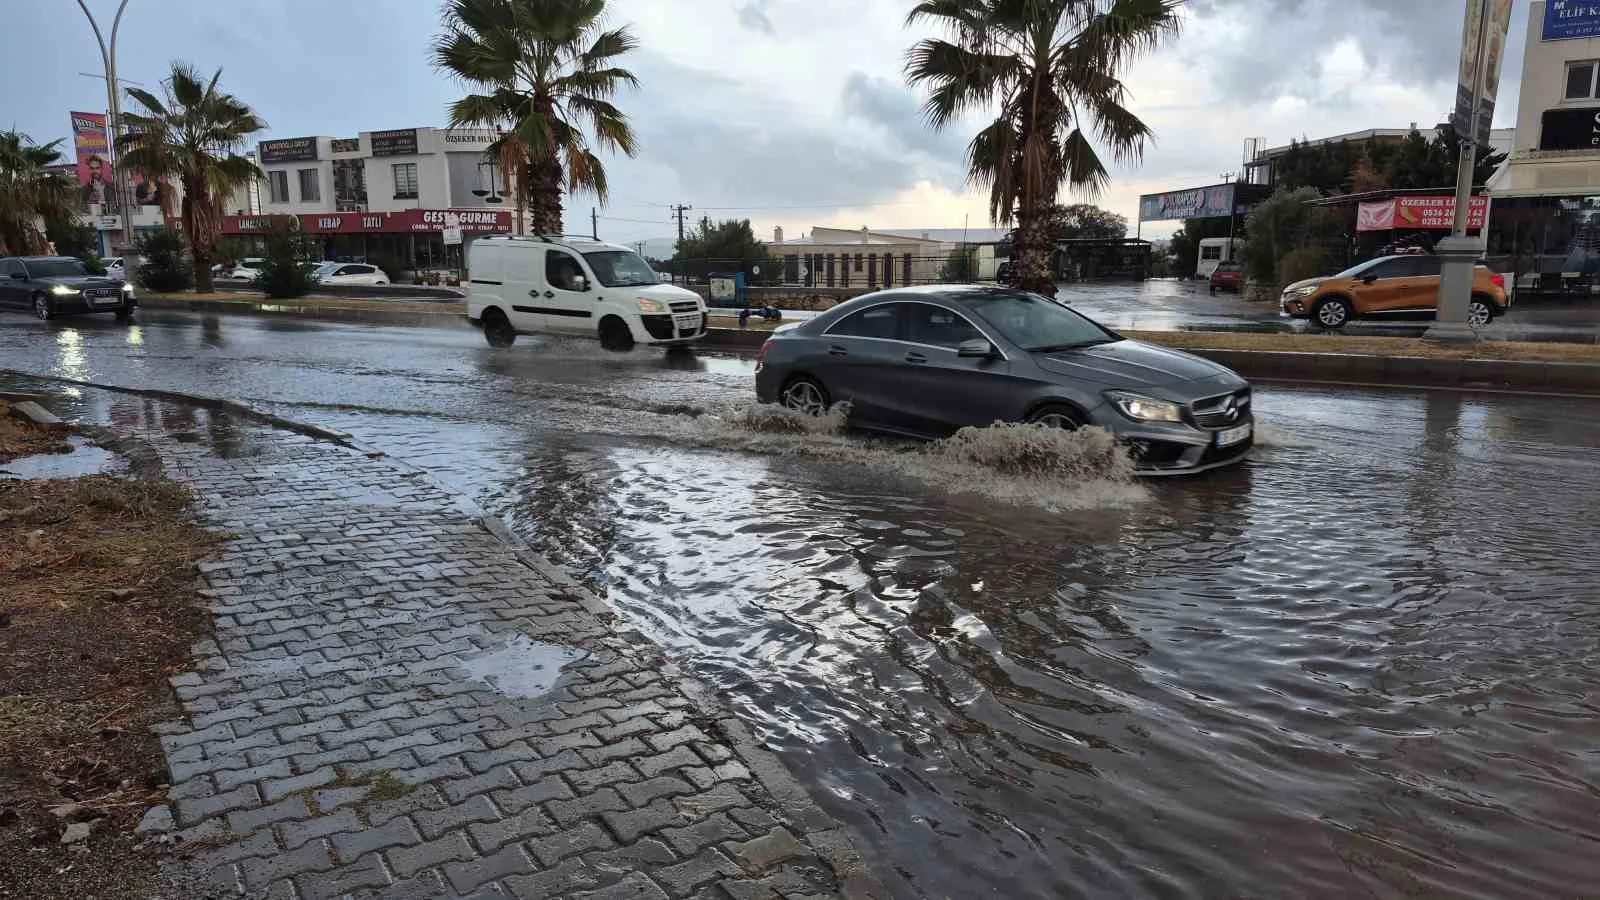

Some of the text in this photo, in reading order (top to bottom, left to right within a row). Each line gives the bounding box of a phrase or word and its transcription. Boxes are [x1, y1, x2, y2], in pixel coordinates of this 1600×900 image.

[1589, 7, 1600, 16] K
[364, 217, 382, 228] TATLI
[424, 211, 497, 224] GEST GURME
[319, 218, 341, 228] KEBAP
